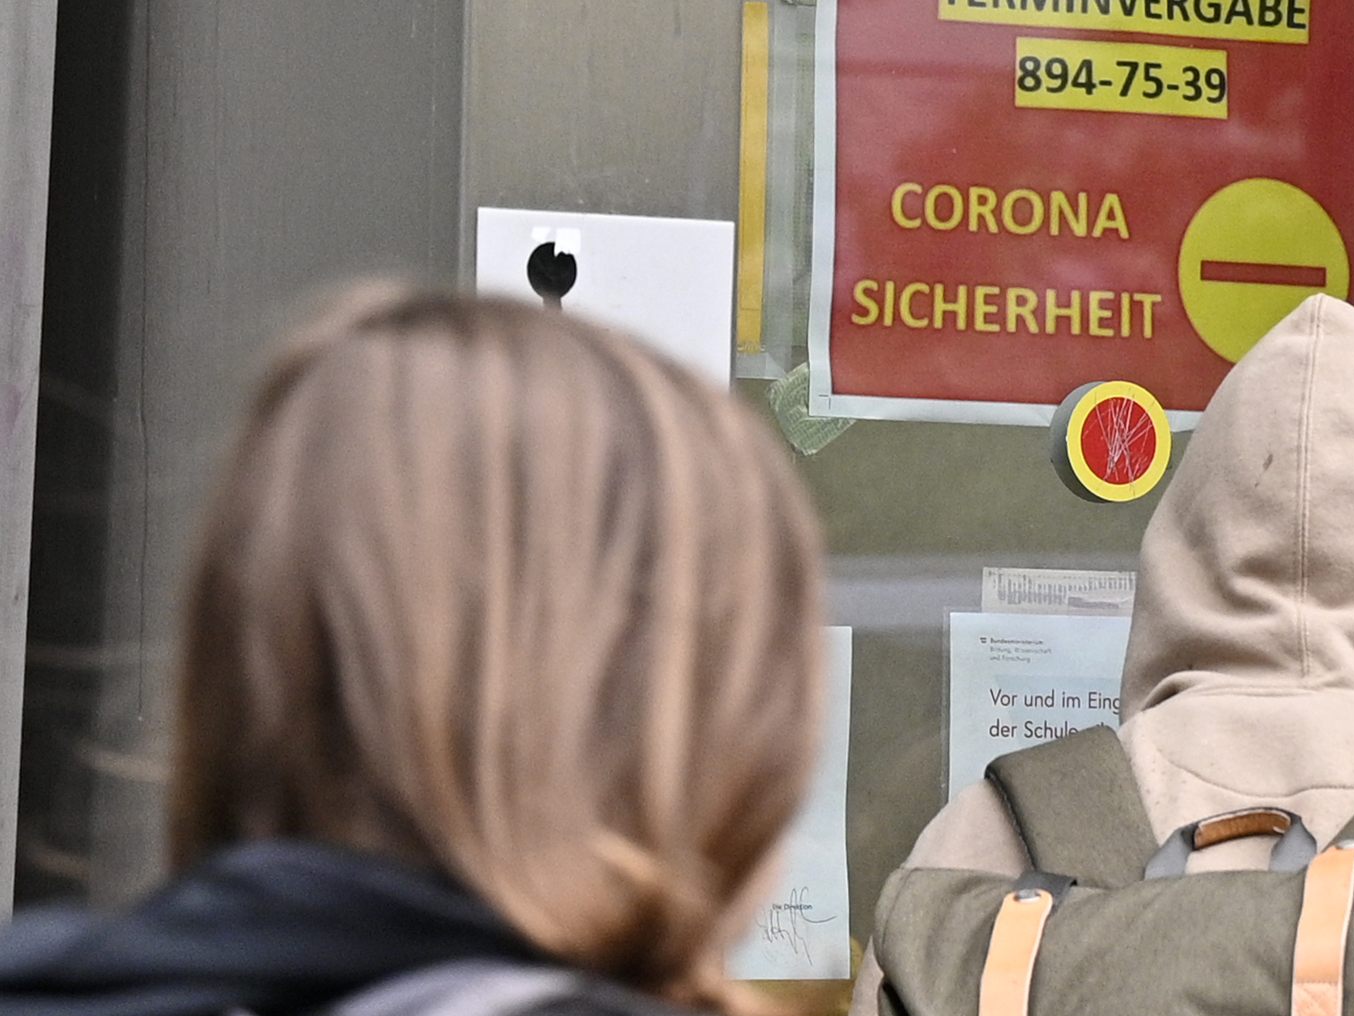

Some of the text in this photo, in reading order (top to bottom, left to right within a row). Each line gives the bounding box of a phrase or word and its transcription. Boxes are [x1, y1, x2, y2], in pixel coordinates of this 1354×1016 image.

[1016, 55, 1227, 104] 894-75-39
[890, 182, 1130, 240] CORONA
[851, 279, 1162, 340] SICHERHEIT
[989, 688, 1018, 707] Vor
[1023, 689, 1055, 708] und
[1062, 691, 1081, 709] im
[988, 718, 1079, 739] der Schule
